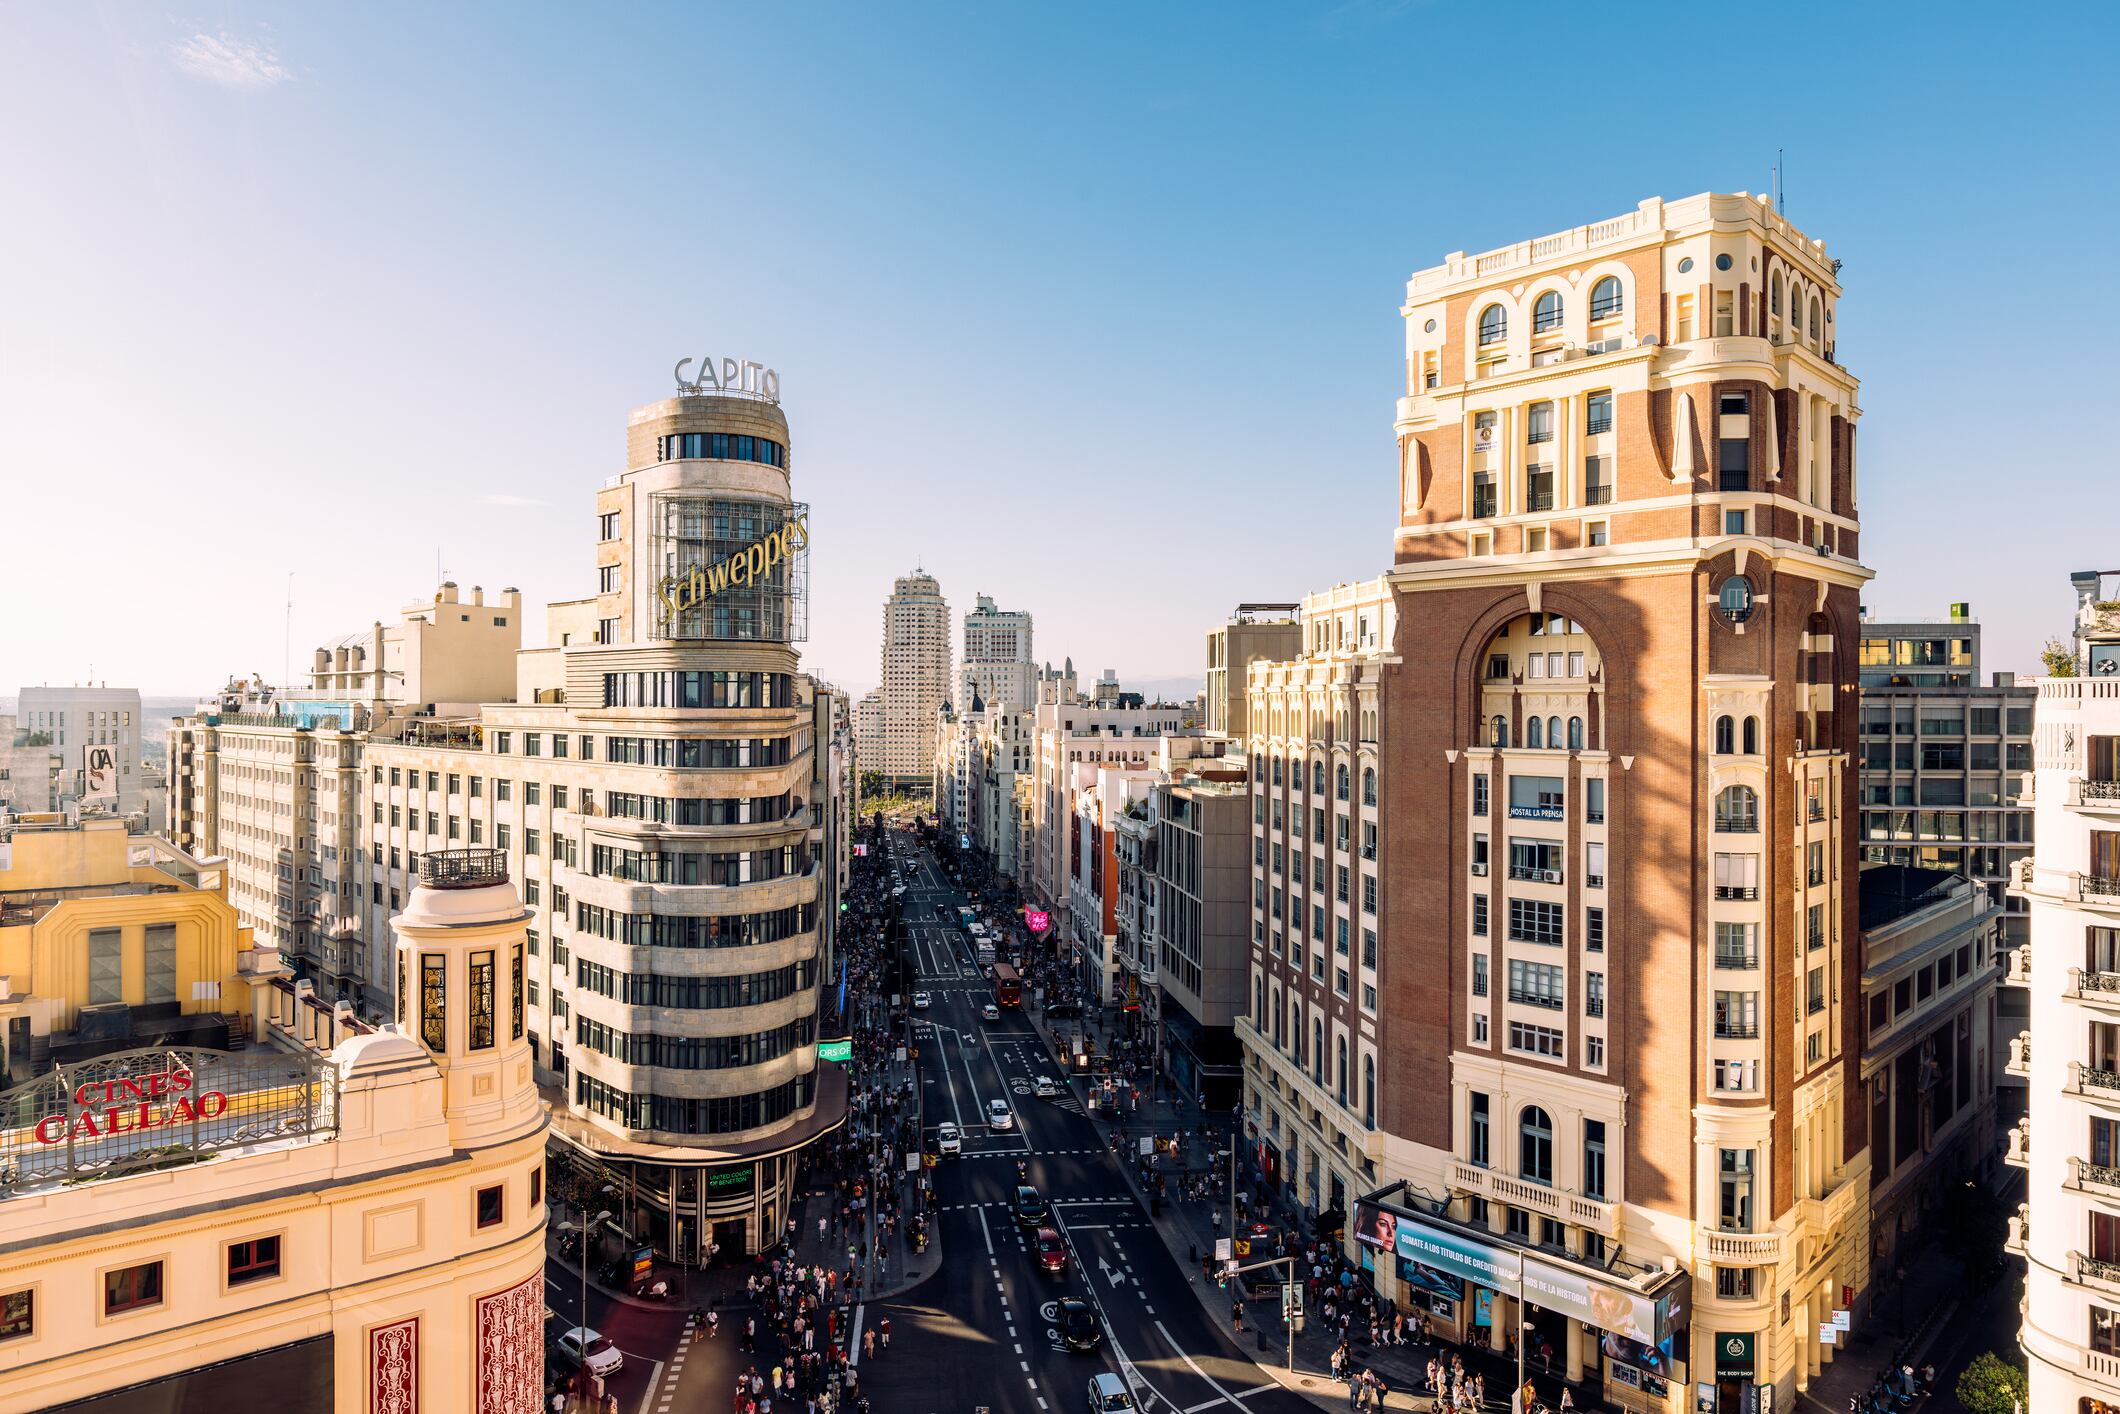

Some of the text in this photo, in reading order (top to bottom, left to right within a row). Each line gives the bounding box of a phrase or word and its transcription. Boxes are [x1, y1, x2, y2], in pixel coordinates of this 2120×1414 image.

[657, 513, 808, 626] Schweppes
[1510, 808, 1564, 818] HOSTAL LA PRENSA
[839, 1046, 852, 1056] OF
[75, 1069, 192, 1107] CINES
[35, 1091, 228, 1145] CALLAO
[719, 1176, 747, 1186] BENETTON
[731, 1168, 752, 1178] COLORS
[1424, 1241, 1429, 1251] A
[1429, 1243, 1440, 1255] LOS
[1464, 1255, 1473, 1266] DE
[1538, 1280, 1548, 1292] DE
[1548, 1284, 1556, 1296] LA
[1556, 1287, 1588, 1307] HISTORIA
